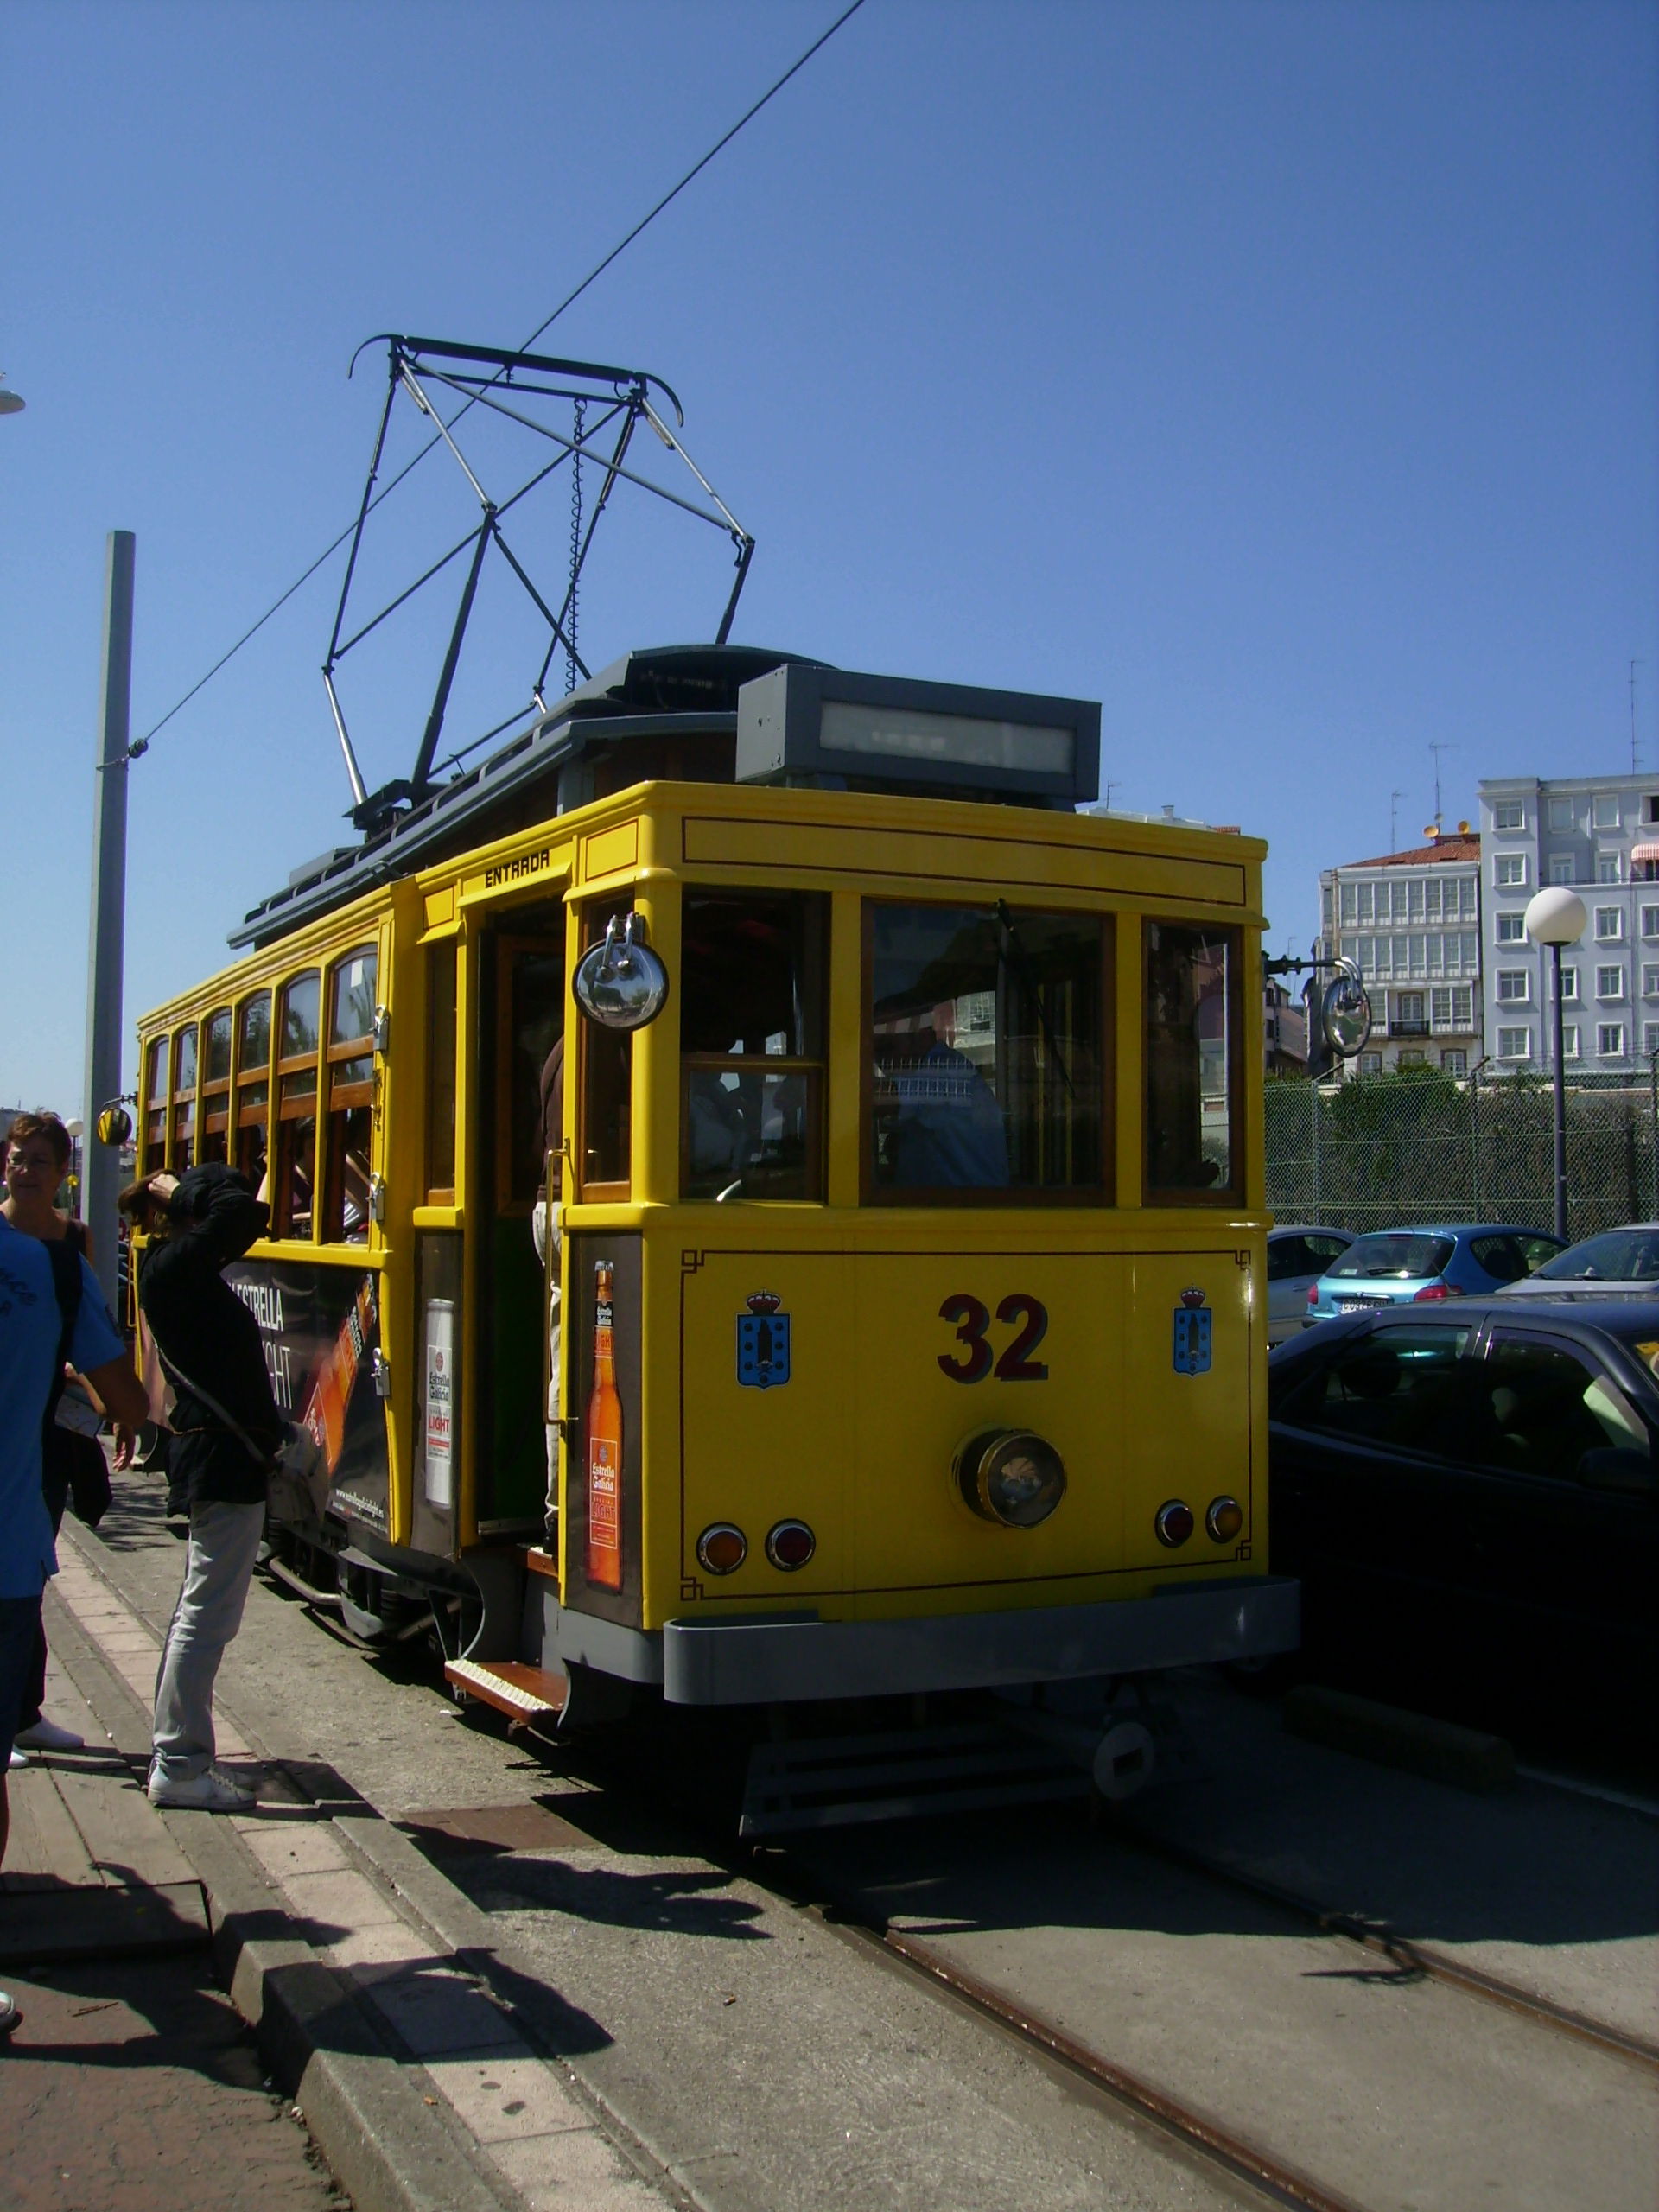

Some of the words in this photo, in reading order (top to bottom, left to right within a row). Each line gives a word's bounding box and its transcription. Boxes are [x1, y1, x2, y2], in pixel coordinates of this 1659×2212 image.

[485, 849, 550, 889] ENTRADA
[937, 1293, 1049, 1384] 32
[429, 1415, 450, 1433] LIGHT
[592, 1462, 615, 1479] Estrella
[592, 1475, 614, 1491] Galicia
